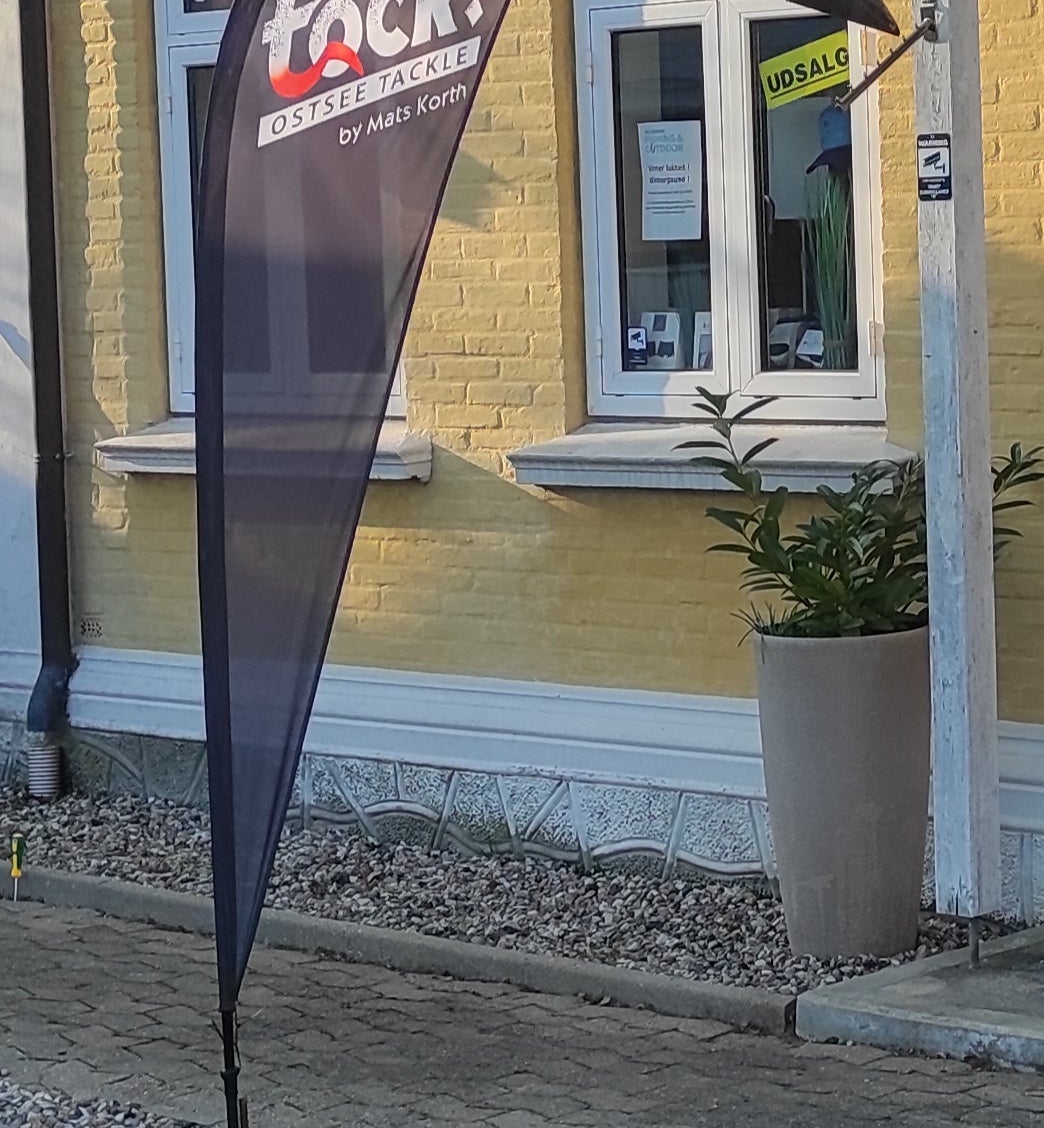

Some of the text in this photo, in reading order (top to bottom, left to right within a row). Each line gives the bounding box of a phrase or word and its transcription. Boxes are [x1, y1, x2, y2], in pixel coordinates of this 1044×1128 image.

[271, 45, 468, 136] OSTSEE TACKLE
[766, 47, 849, 93] UDSALG
[338, 82, 467, 146] by Mats Korth
